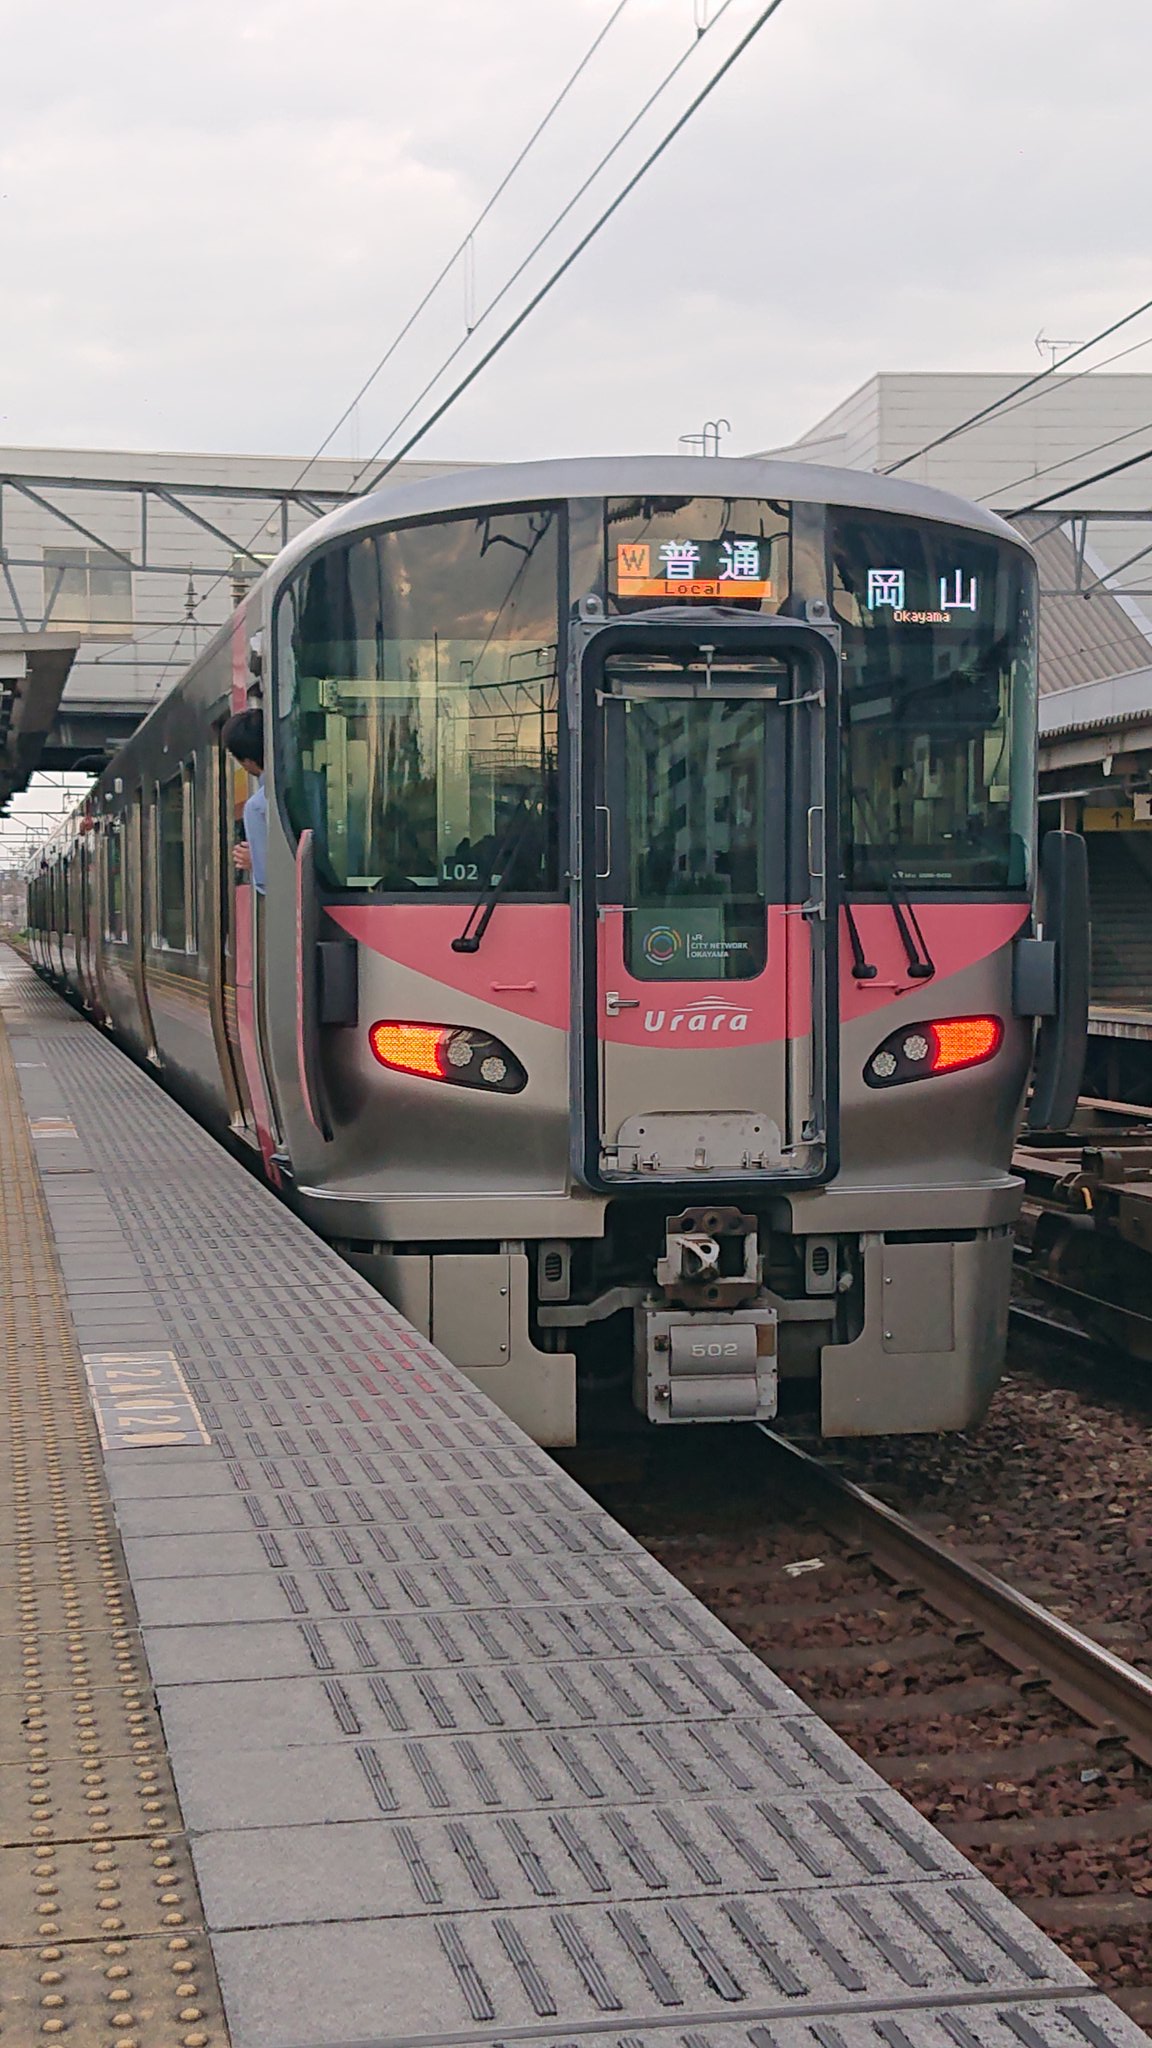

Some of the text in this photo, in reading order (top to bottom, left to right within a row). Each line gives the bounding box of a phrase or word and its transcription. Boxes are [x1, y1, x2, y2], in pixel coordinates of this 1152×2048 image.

[658, 540, 761, 581] 普通
[664, 581, 721, 595] Local
[867, 568, 977, 611] 岡山
[892, 610, 951, 624] Okayama
[442, 864, 478, 881] L02
[691, 933, 703, 941] JR
[690, 942, 748, 950] CITY NETWORK
[643, 1010, 748, 1031] Urara
[691, 1343, 739, 1357] 502
